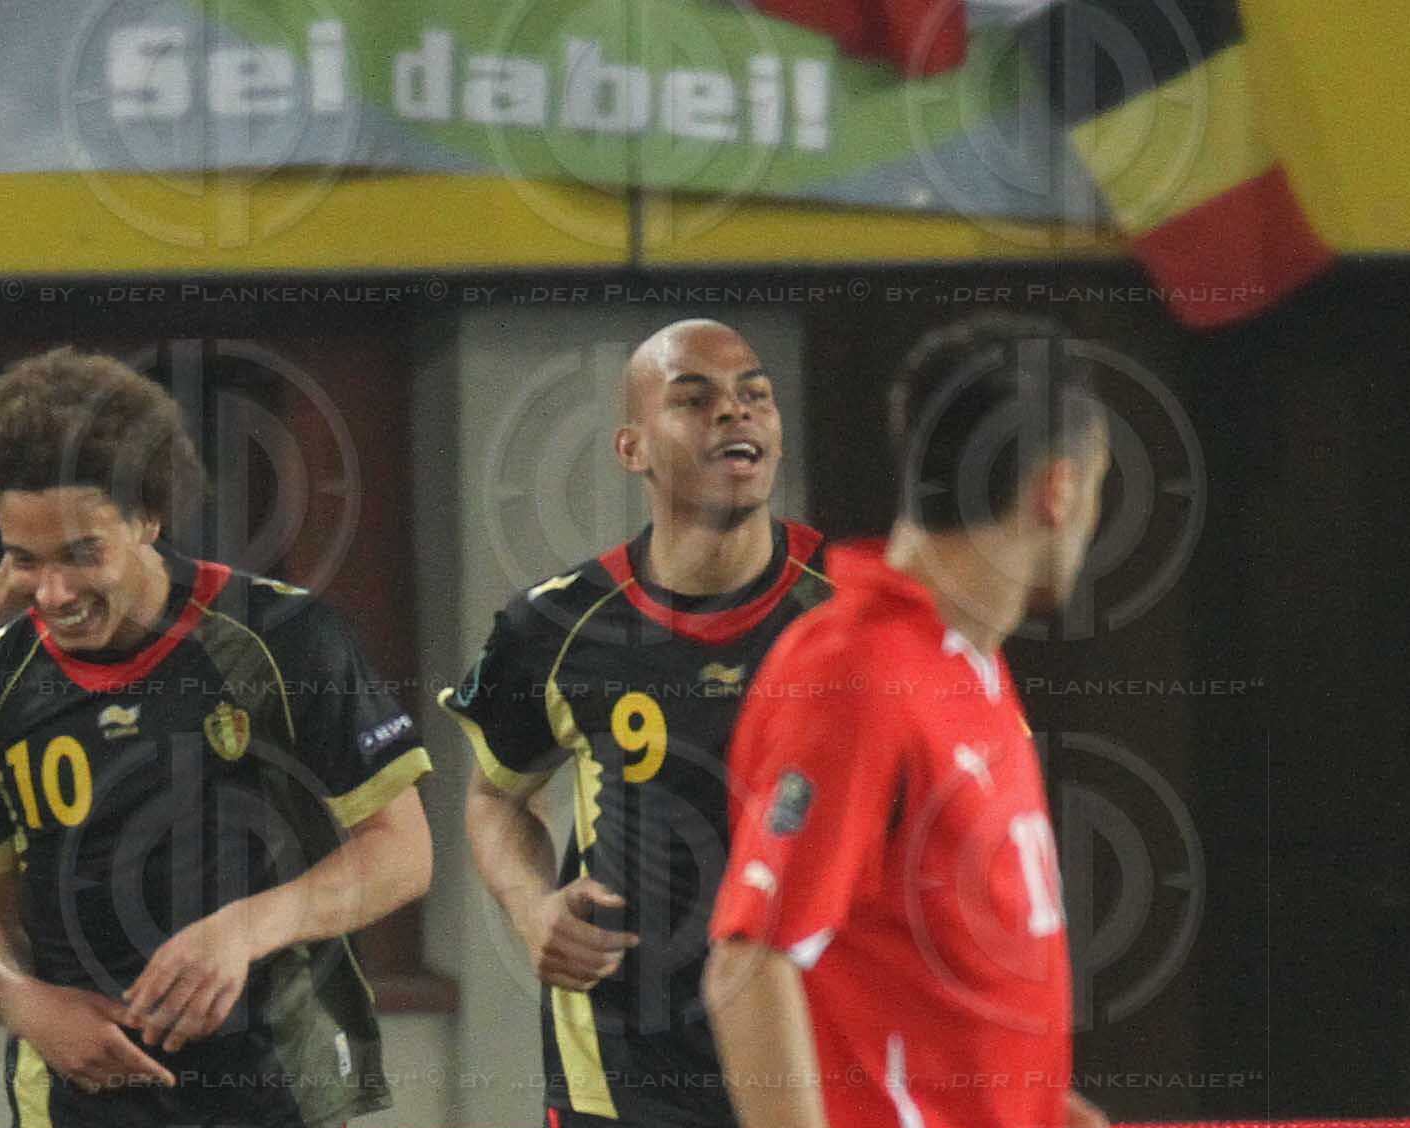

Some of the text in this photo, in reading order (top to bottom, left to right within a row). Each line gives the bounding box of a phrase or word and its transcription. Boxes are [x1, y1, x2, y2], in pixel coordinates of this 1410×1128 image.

[107, 19, 829, 152] Sei dabei!
[5, 735, 94, 829] 10
[611, 691, 668, 783] 9
